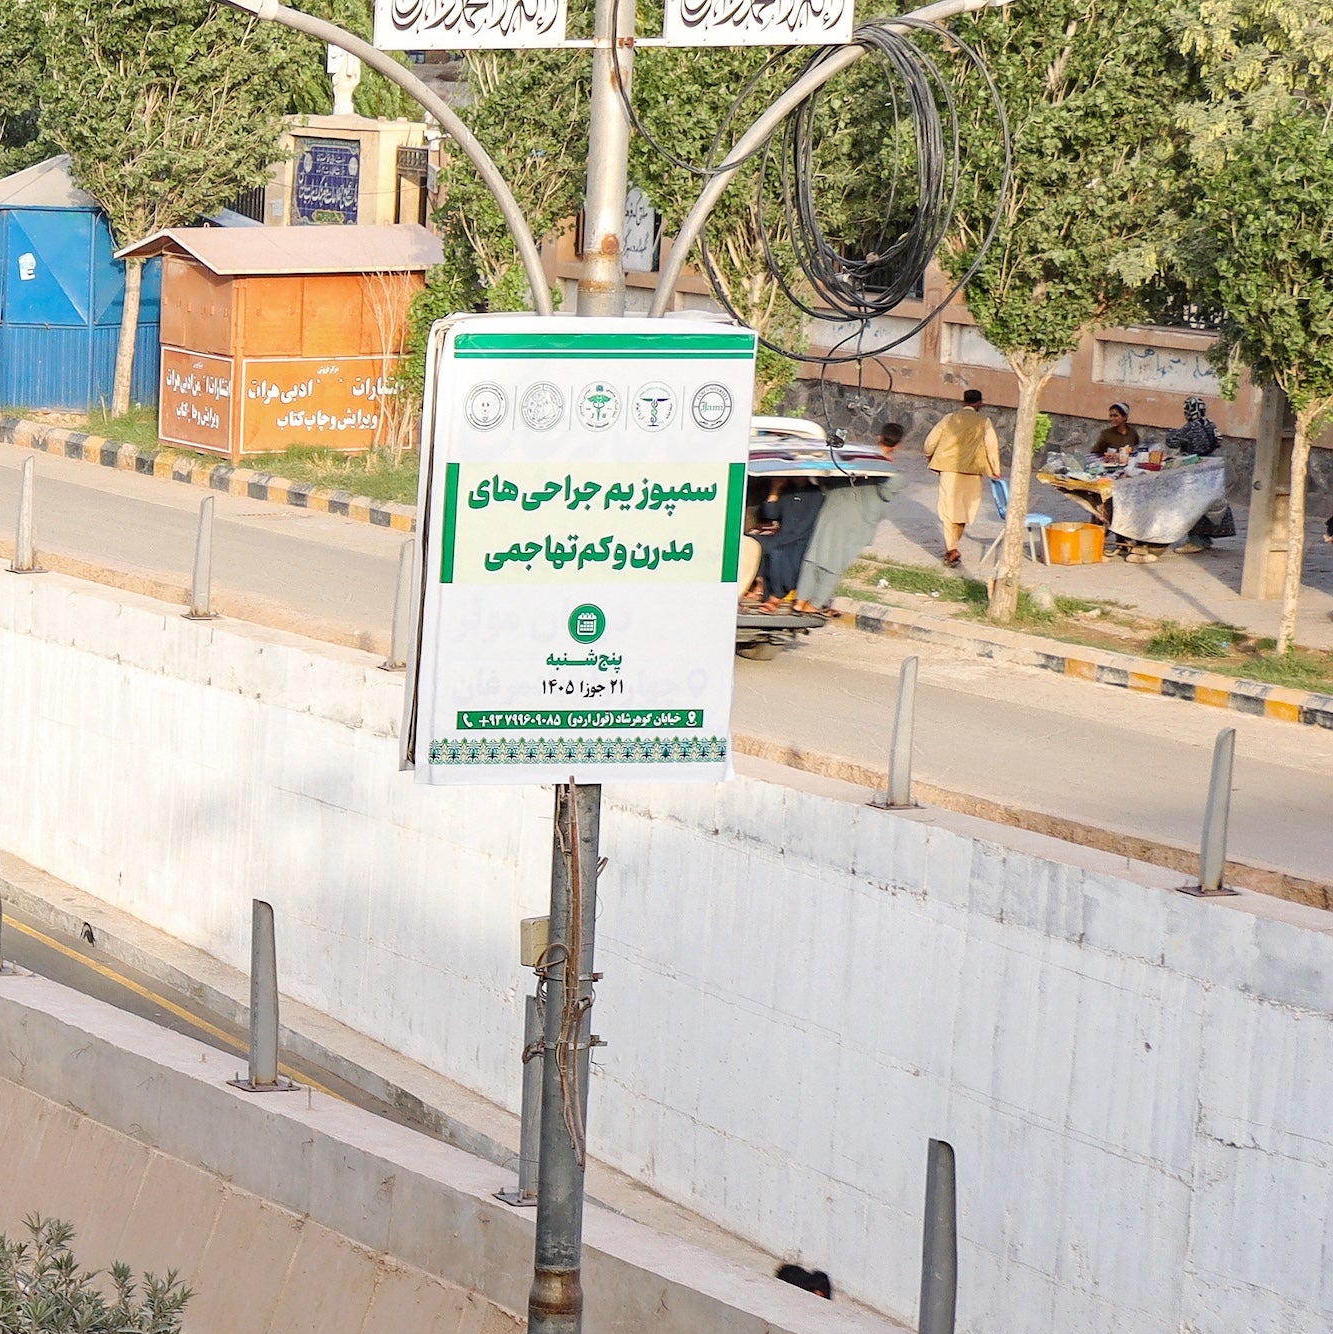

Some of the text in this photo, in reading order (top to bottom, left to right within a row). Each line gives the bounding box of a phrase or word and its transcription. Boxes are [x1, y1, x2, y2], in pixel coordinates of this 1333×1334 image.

[248, 379, 280, 405] هرات
[280, 378, 313, 404] ادبی
[276, 408, 378, 432] ویرایش و چاپ کتاب
[467, 473, 718, 517] سمپوزیم جراحی های
[612, 545, 628, 571] و
[630, 539, 694, 571] مدرن
[542, 679, 623, 698] ۲۱ جوزا ۱۴۰۵
[653, 712, 682, 727] خیابان
